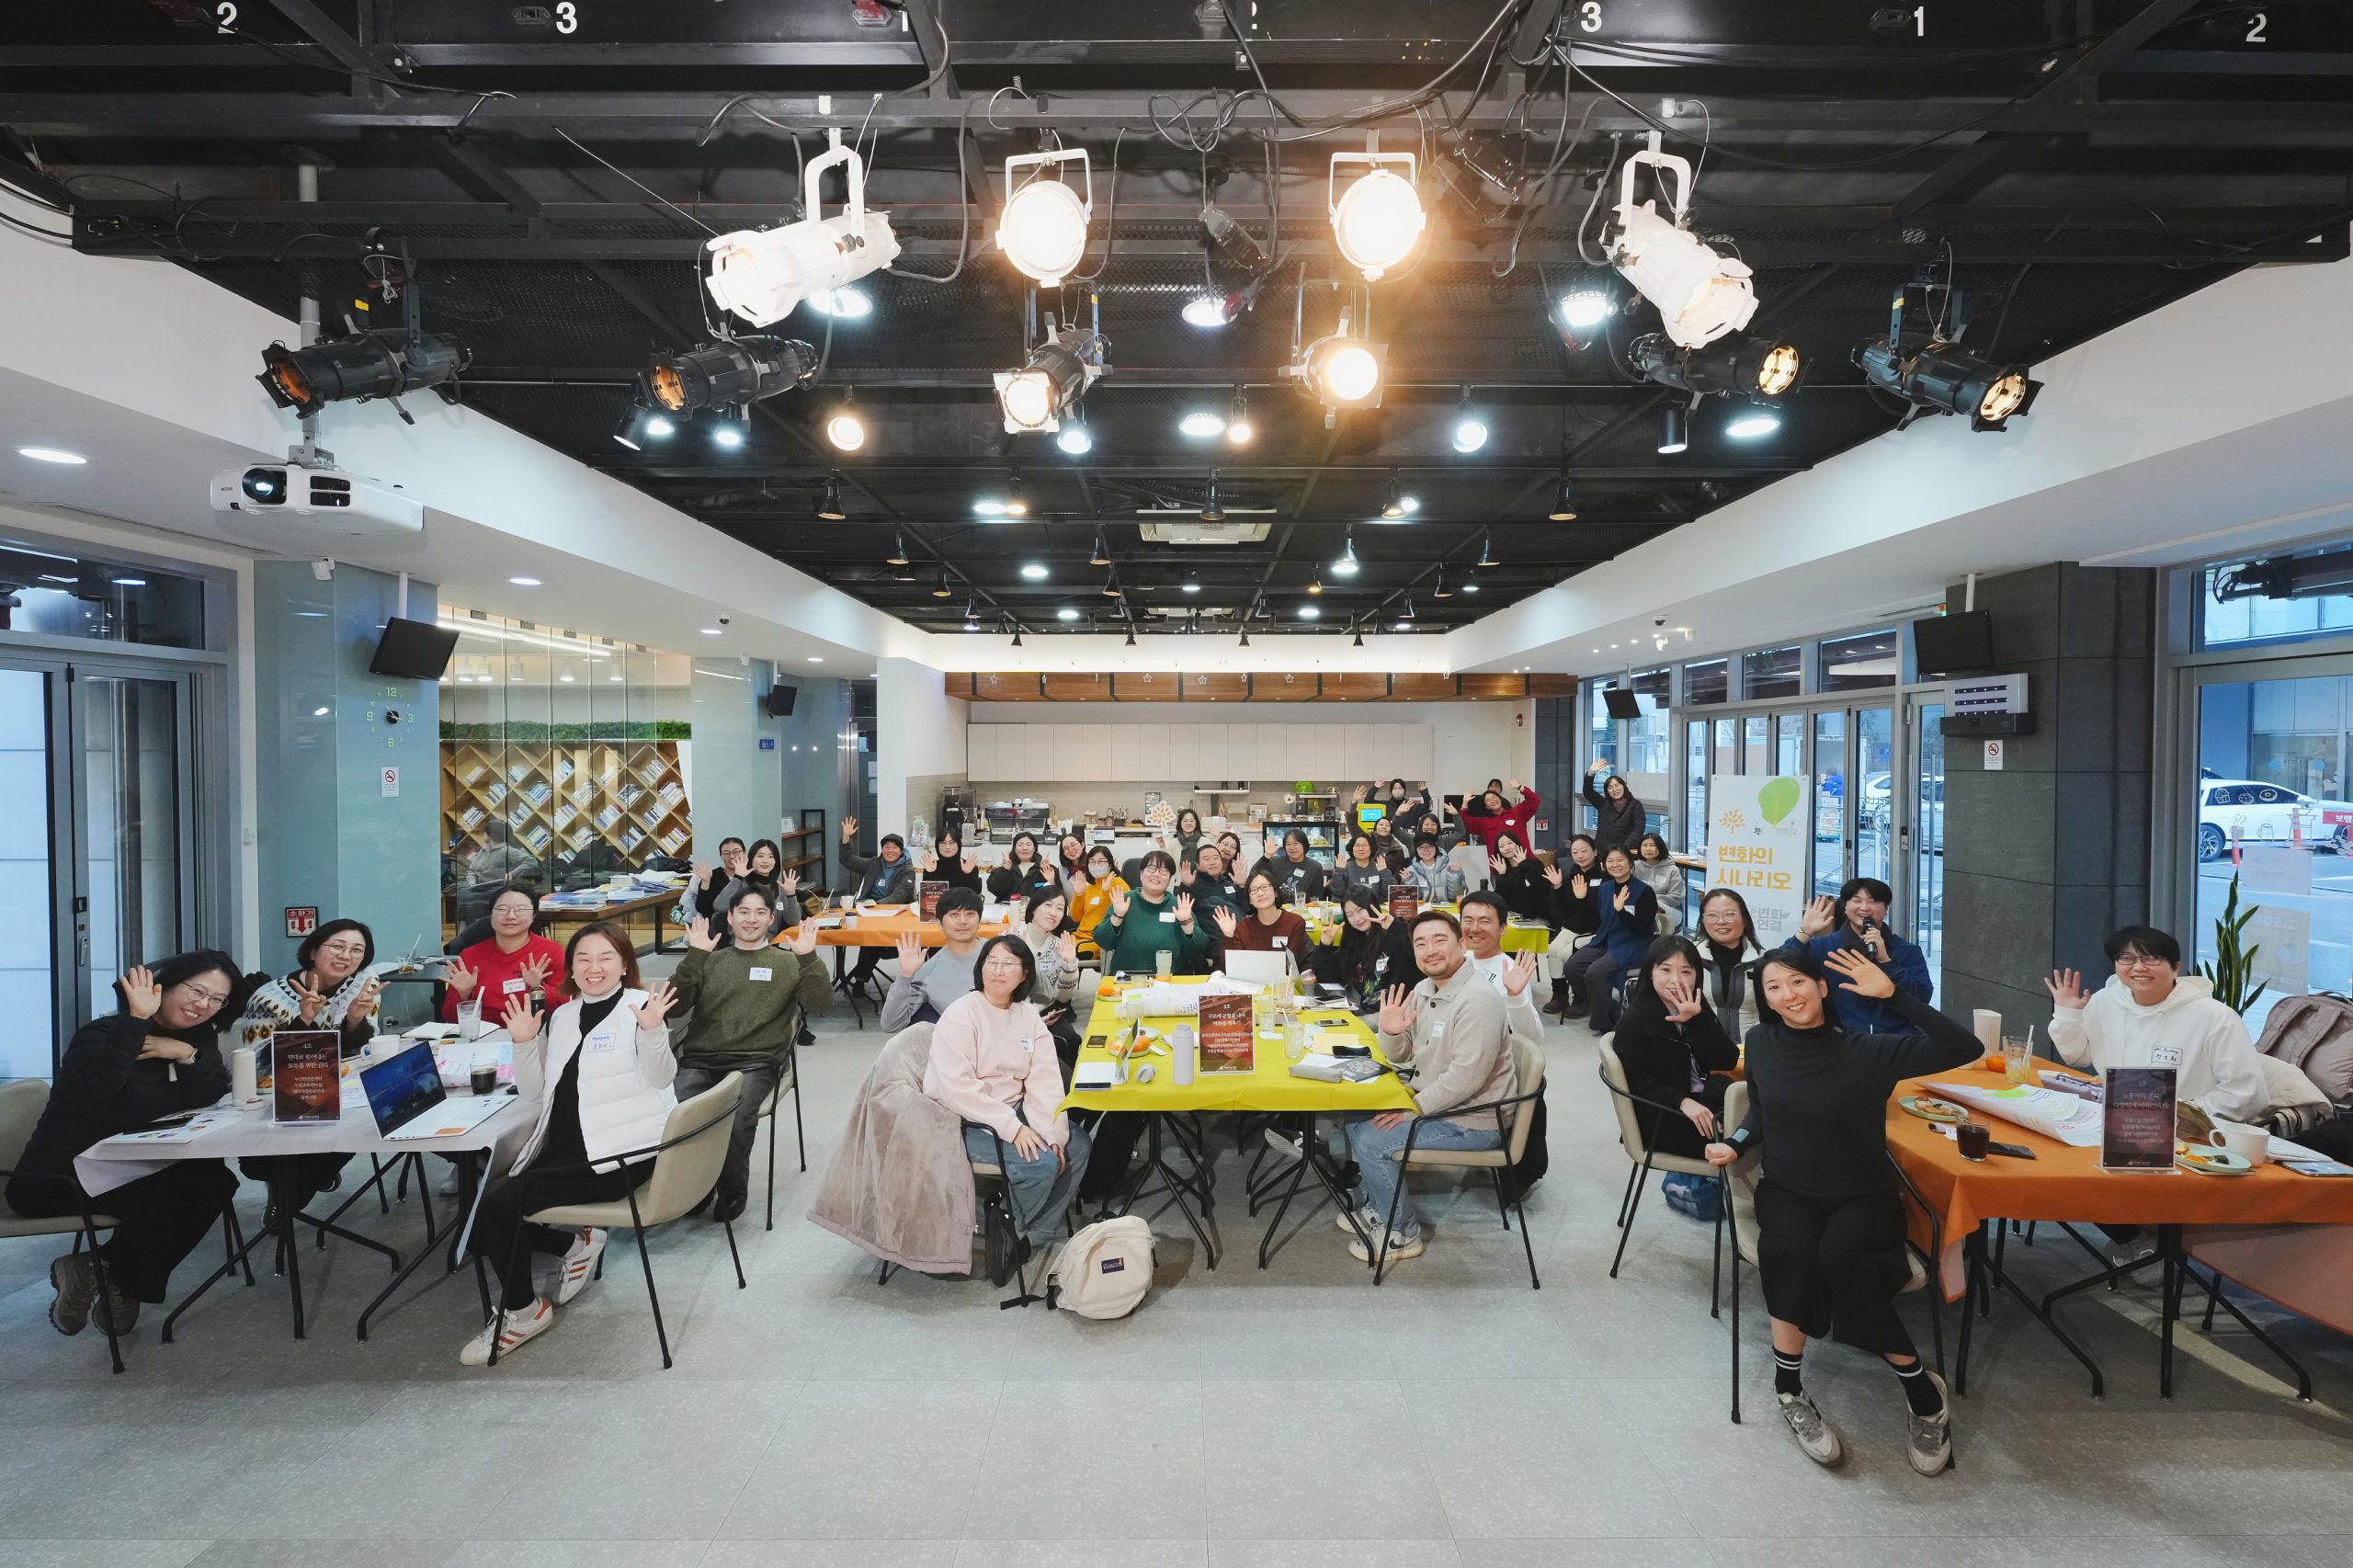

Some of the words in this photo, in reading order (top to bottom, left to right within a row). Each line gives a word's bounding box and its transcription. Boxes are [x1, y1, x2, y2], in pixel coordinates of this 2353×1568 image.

[217, 1, 237, 34] 2
[555, 1, 578, 34] 3
[1580, 1, 1603, 33] 3
[1914, 6, 1924, 37] 1
[2245, 13, 2267, 42] 2
[386, 687, 397, 698] 12
[367, 711, 373, 722] 9
[407, 713, 414, 723] 3
[387, 737, 394, 747] 6
[2336, 814, 2353, 824] 보행
[1718, 845, 1774, 865] 변화의
[1716, 868, 1792, 891] 시나리오
[1757, 907, 1782, 919] 변화
